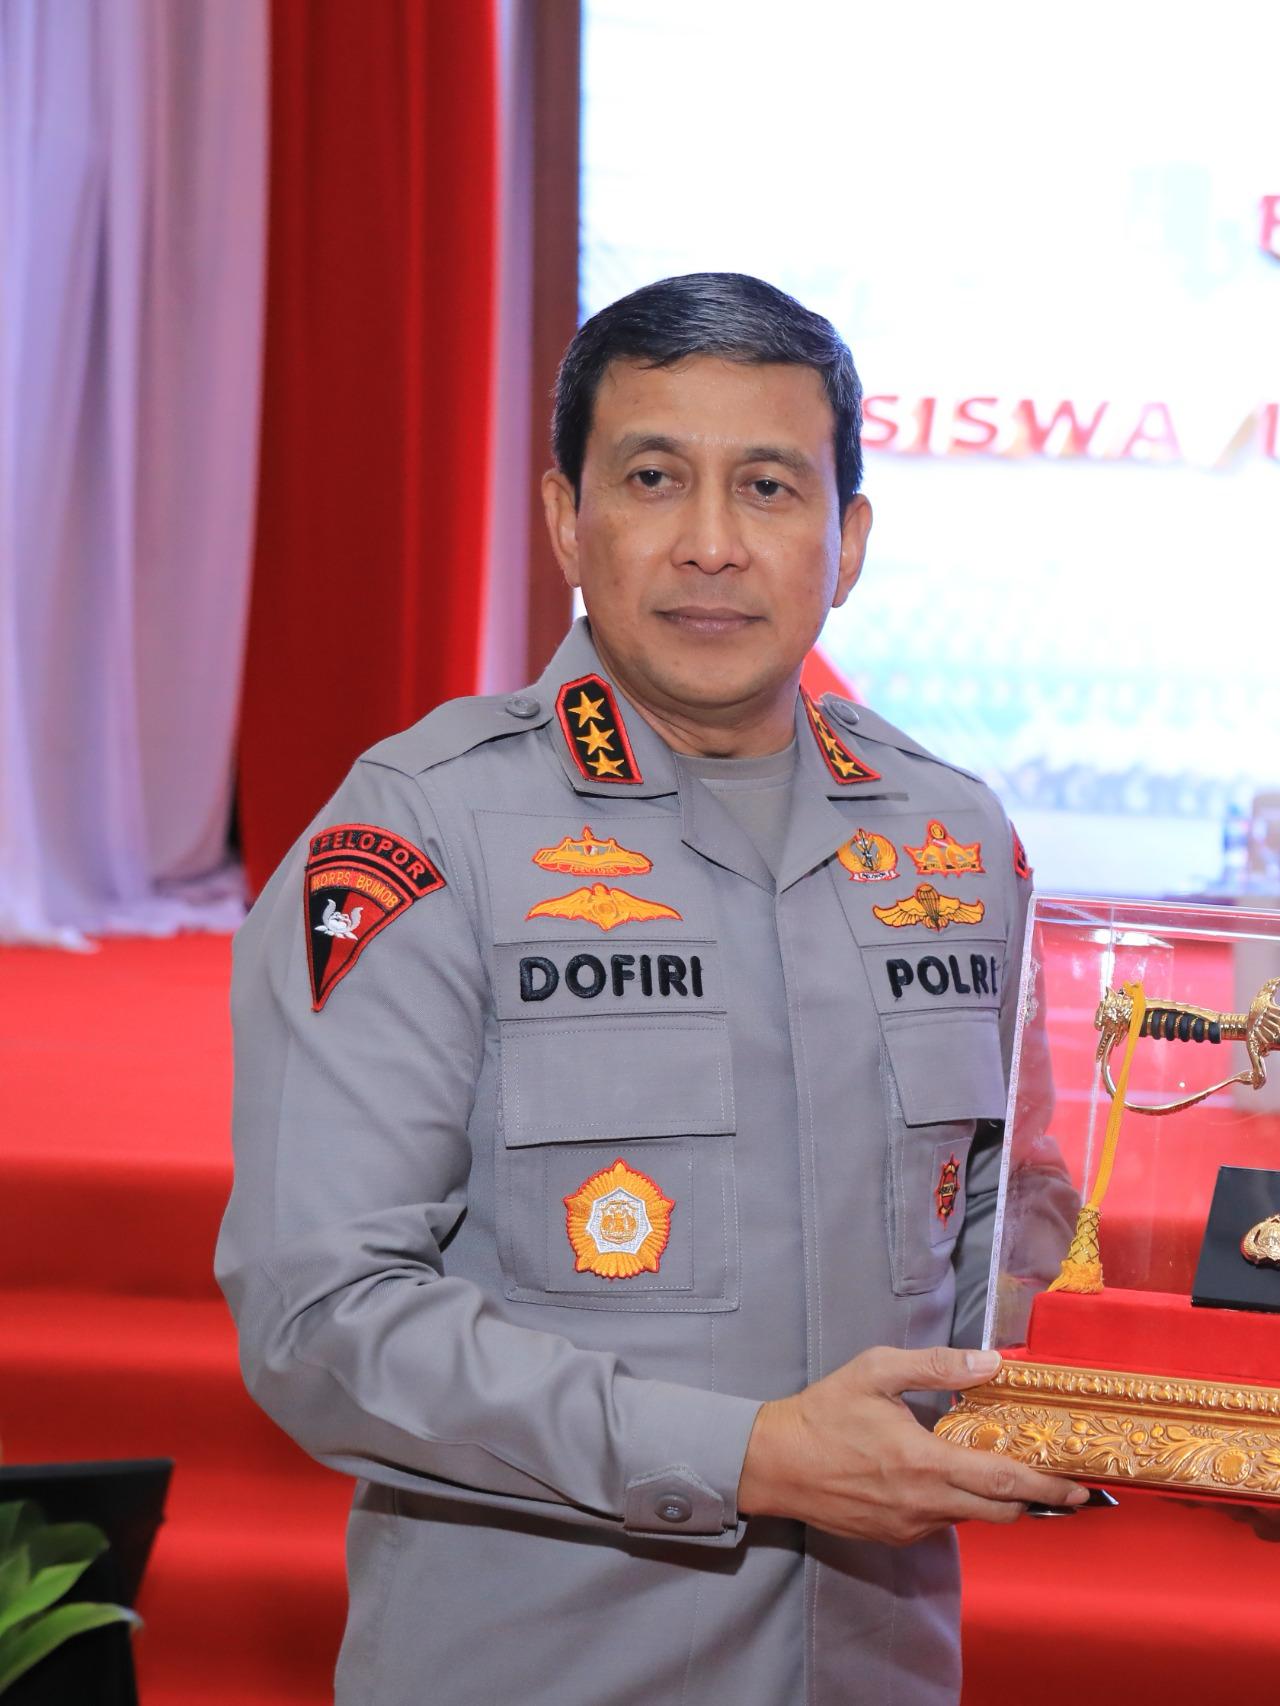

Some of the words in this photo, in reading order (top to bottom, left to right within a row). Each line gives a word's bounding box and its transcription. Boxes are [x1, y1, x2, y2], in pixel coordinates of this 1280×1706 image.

[860, 396, 1184, 460] SISWA
[319, 831, 426, 880] PELOPOR
[311, 871, 352, 893] KORPS
[356, 872, 400, 908] BRIMOB
[520, 954, 705, 1002] DOFIRI
[886, 953, 998, 999] POLRI
